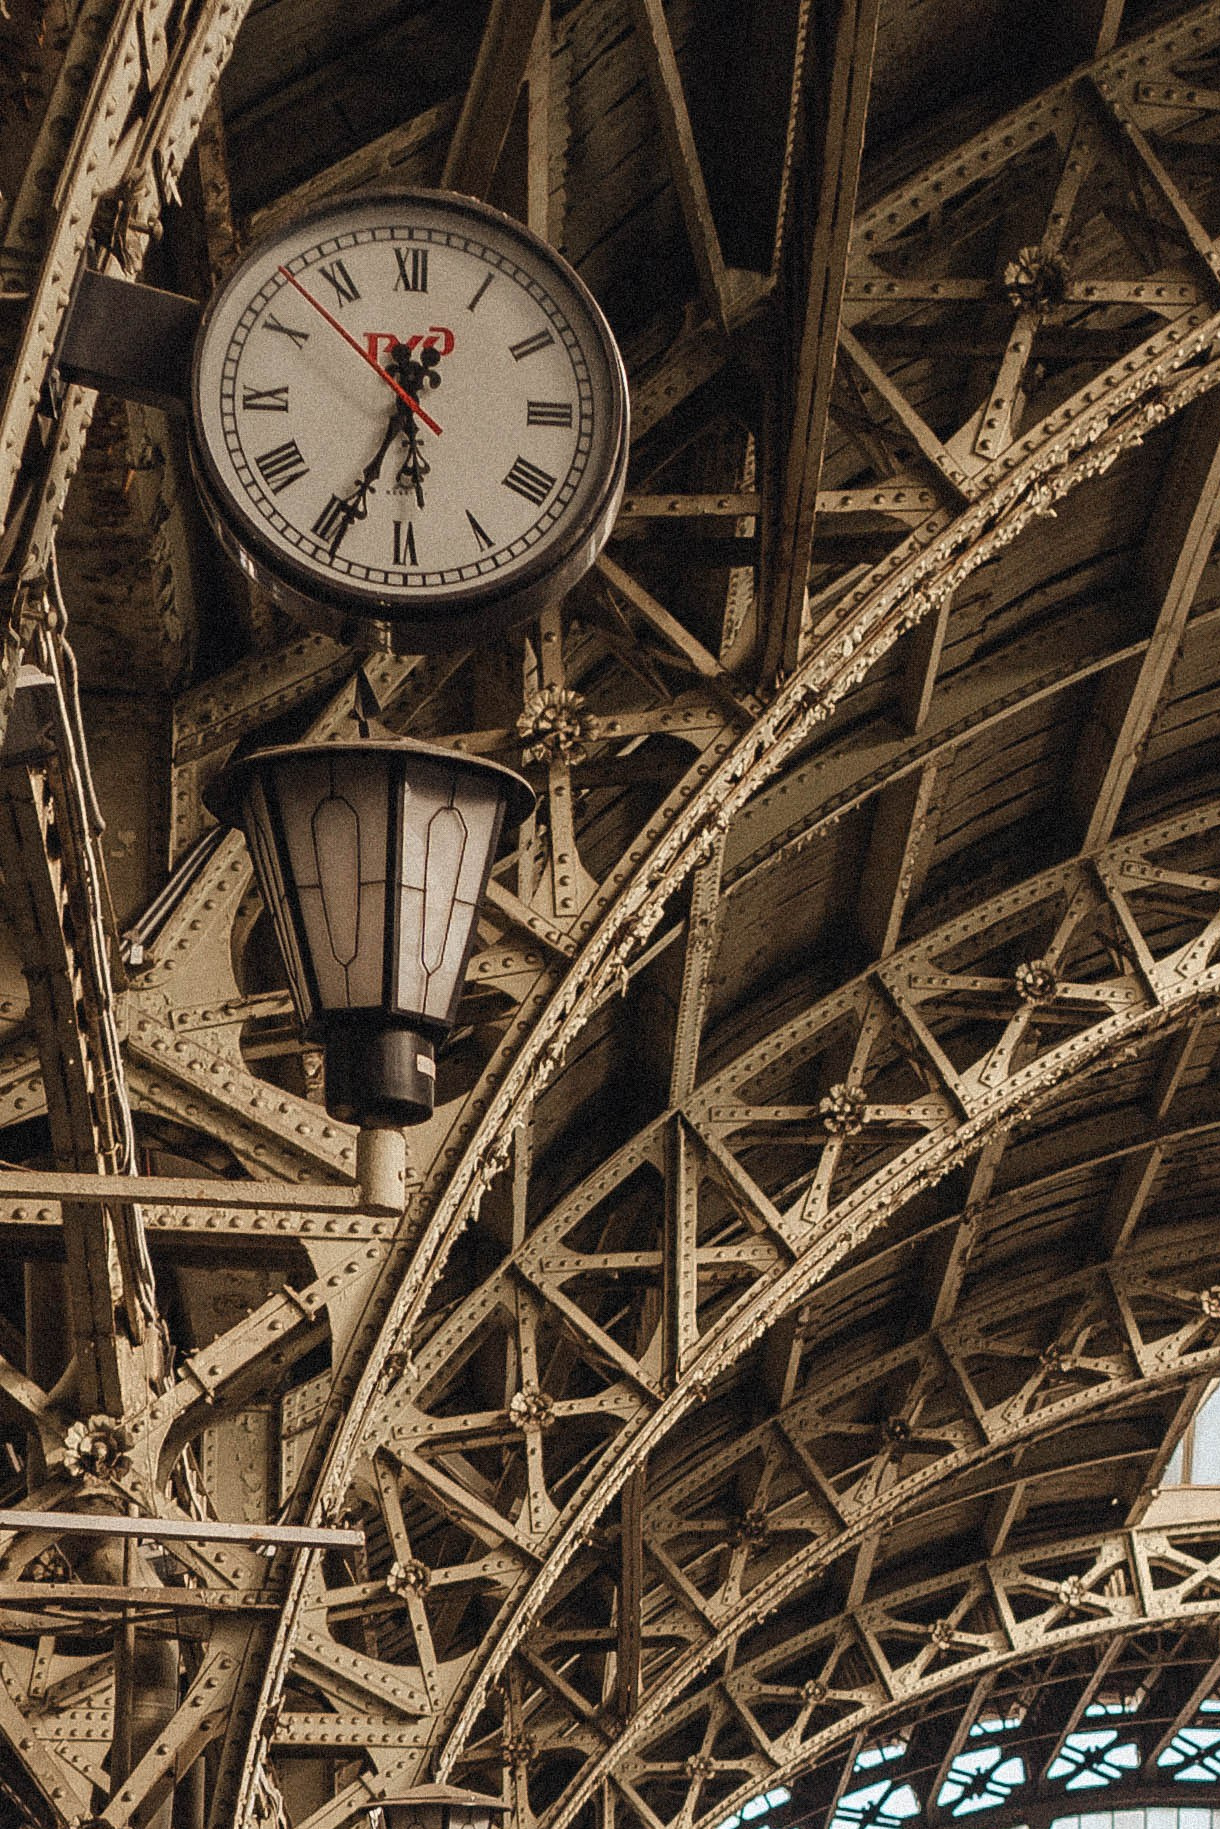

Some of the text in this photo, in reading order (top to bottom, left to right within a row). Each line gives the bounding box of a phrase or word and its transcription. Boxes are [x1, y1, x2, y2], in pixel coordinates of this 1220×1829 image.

[318, 259, 361, 308] XI
[393, 247, 428, 293] XII
[466, 272, 495, 312] I
[262, 312, 310, 350] X
[509, 327, 555, 362] II
[242, 384, 289, 413] IX
[526, 399, 573, 428] III
[254, 438, 310, 496] VIII
[501, 455, 557, 507] IIII
[392, 519, 420, 566] VI
[465, 509, 495, 552] V
